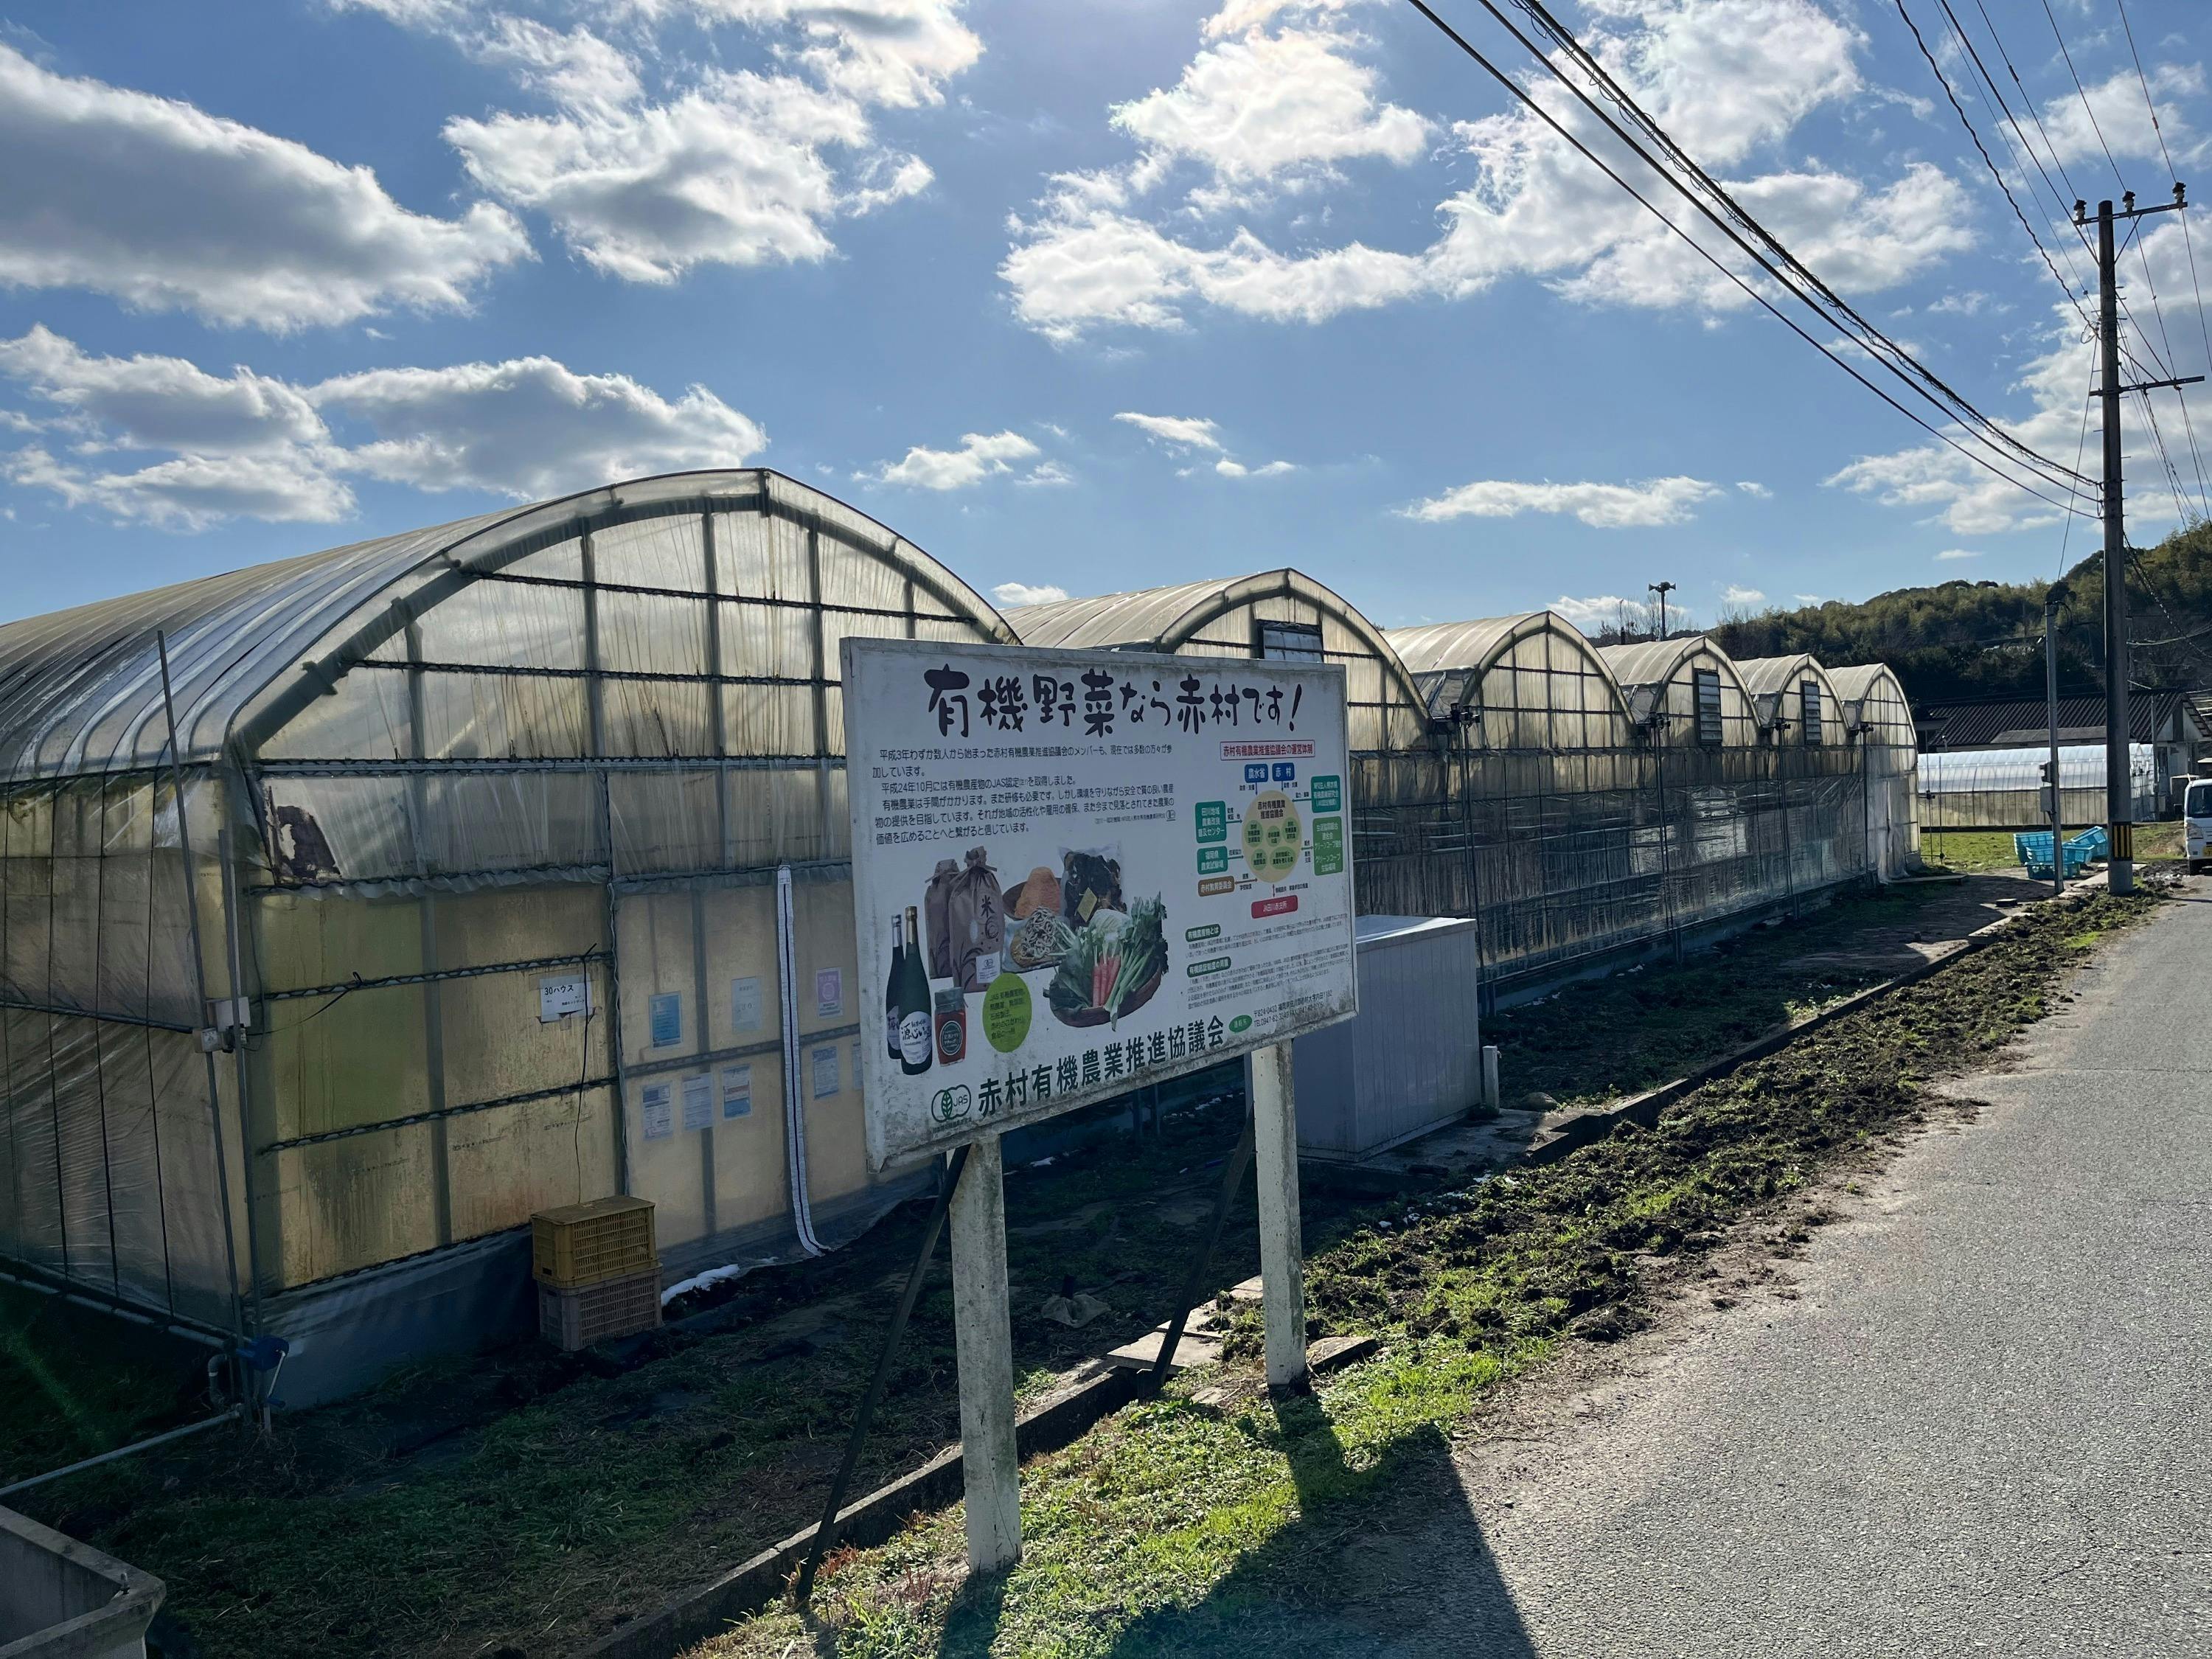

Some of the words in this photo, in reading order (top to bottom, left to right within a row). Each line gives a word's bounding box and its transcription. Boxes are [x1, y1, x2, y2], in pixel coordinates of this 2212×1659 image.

[872, 765, 925, 779] 加しています。
[978, 1015, 1225, 1119] 赤村有機農業推進協議会
[953, 1094, 969, 1107] JAS
